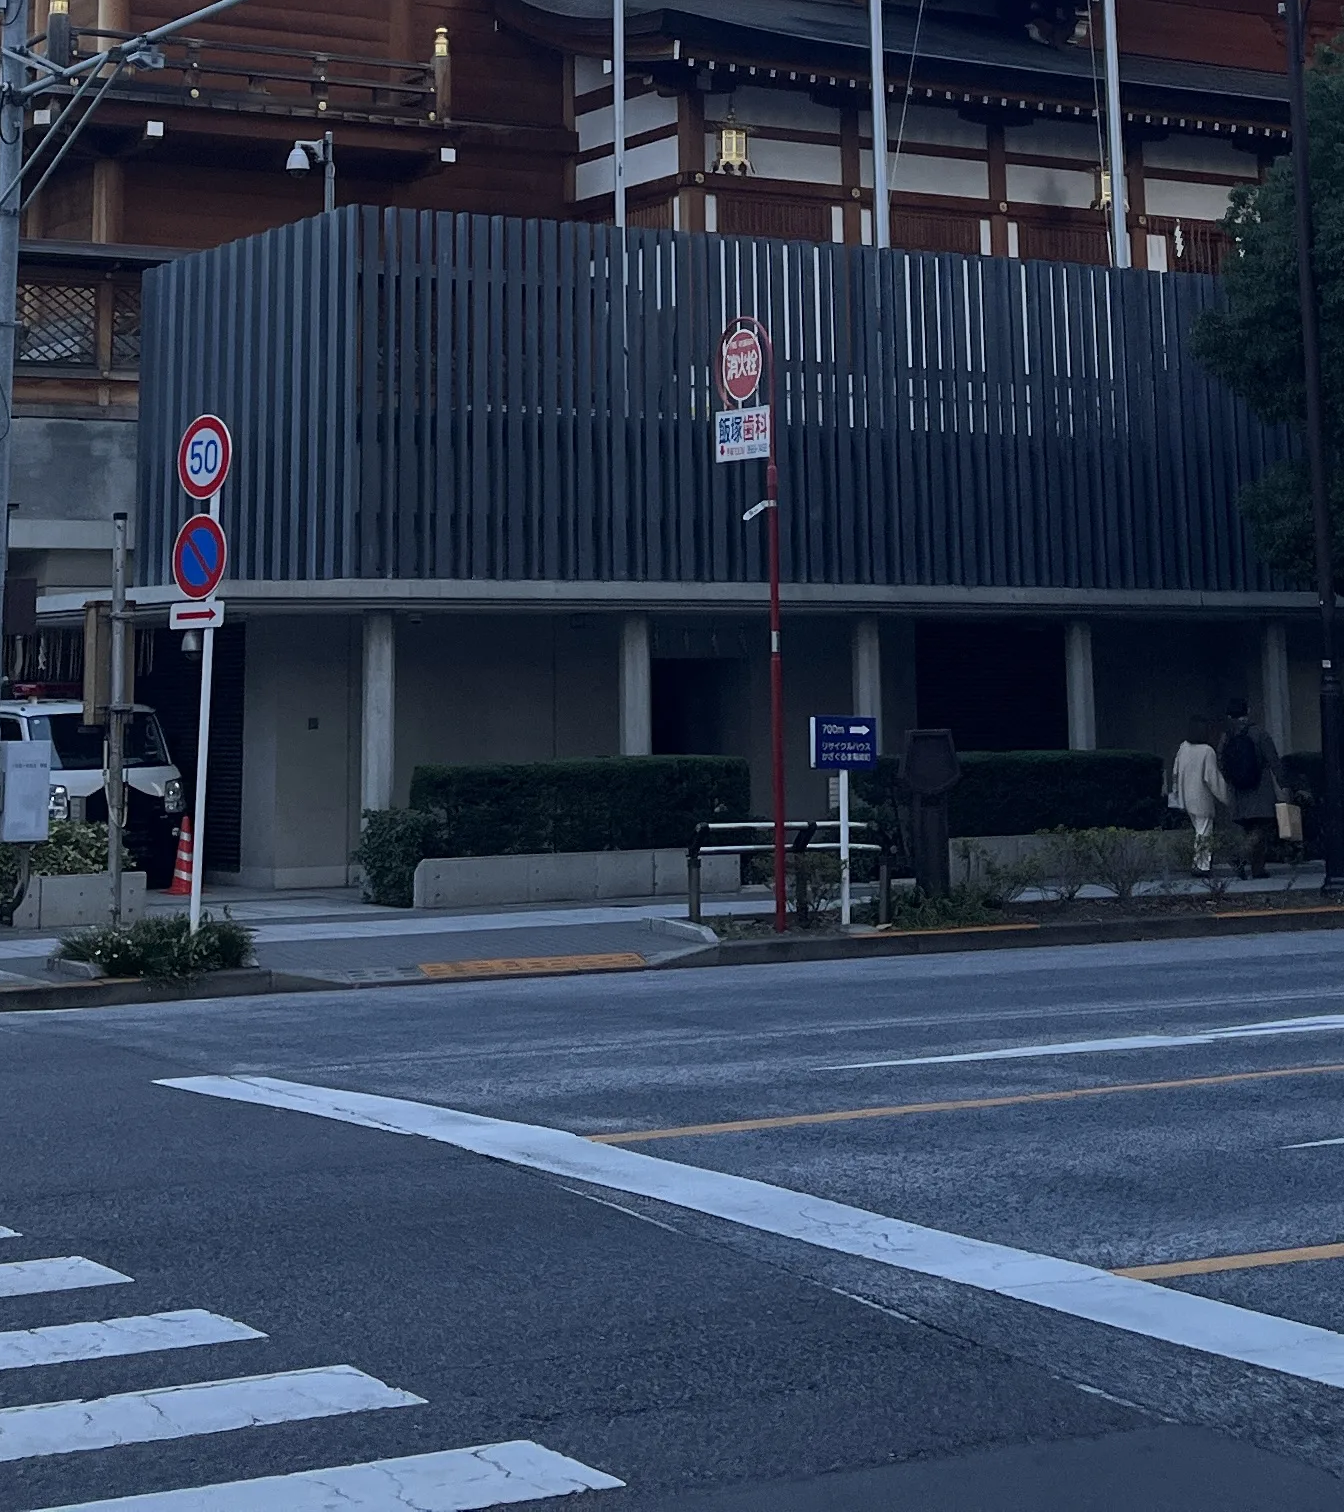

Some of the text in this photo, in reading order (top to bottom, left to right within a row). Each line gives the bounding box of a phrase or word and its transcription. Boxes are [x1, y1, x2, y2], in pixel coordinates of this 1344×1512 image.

[726, 349, 758, 381] 消火栓
[718, 412, 768, 445] 飯塚歯科
[190, 439, 218, 475] 50
[821, 724, 845, 735] 700m
[821, 741, 872, 752] リサイクルハウス
